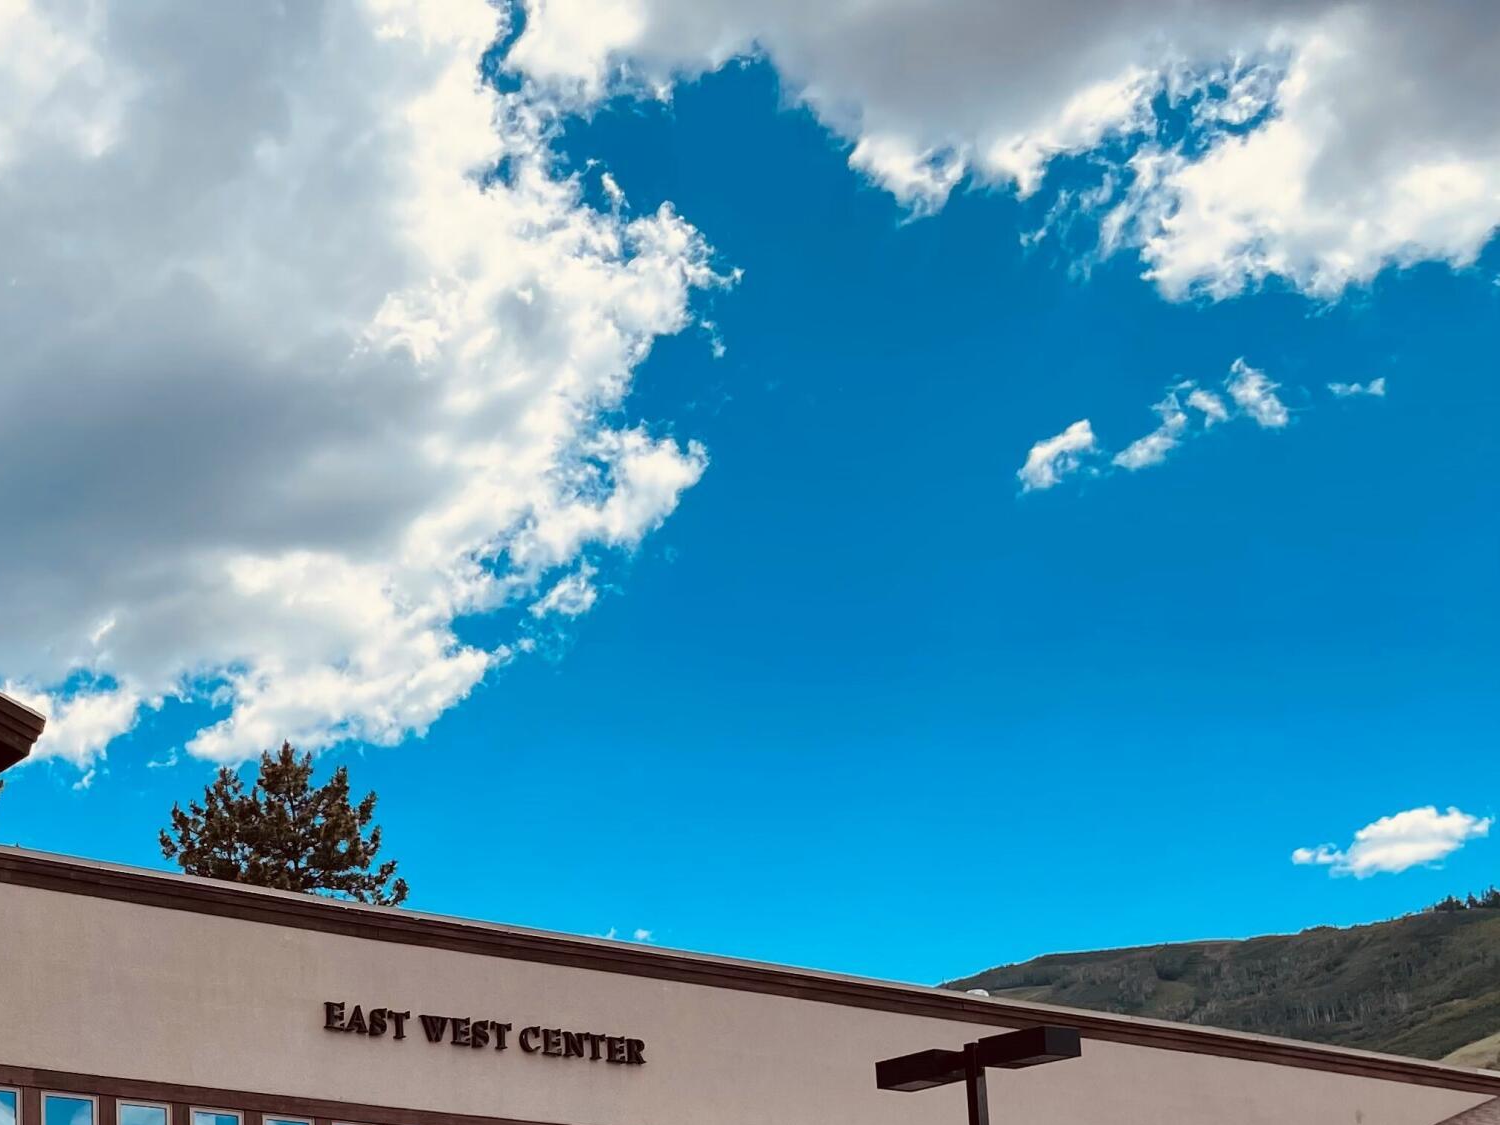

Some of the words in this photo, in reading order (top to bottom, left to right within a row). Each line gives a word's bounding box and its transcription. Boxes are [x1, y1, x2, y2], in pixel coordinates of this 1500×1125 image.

[323, 1001, 410, 1039] EAST
[419, 1014, 512, 1050] WEST
[518, 1026, 647, 1065] CENTER
